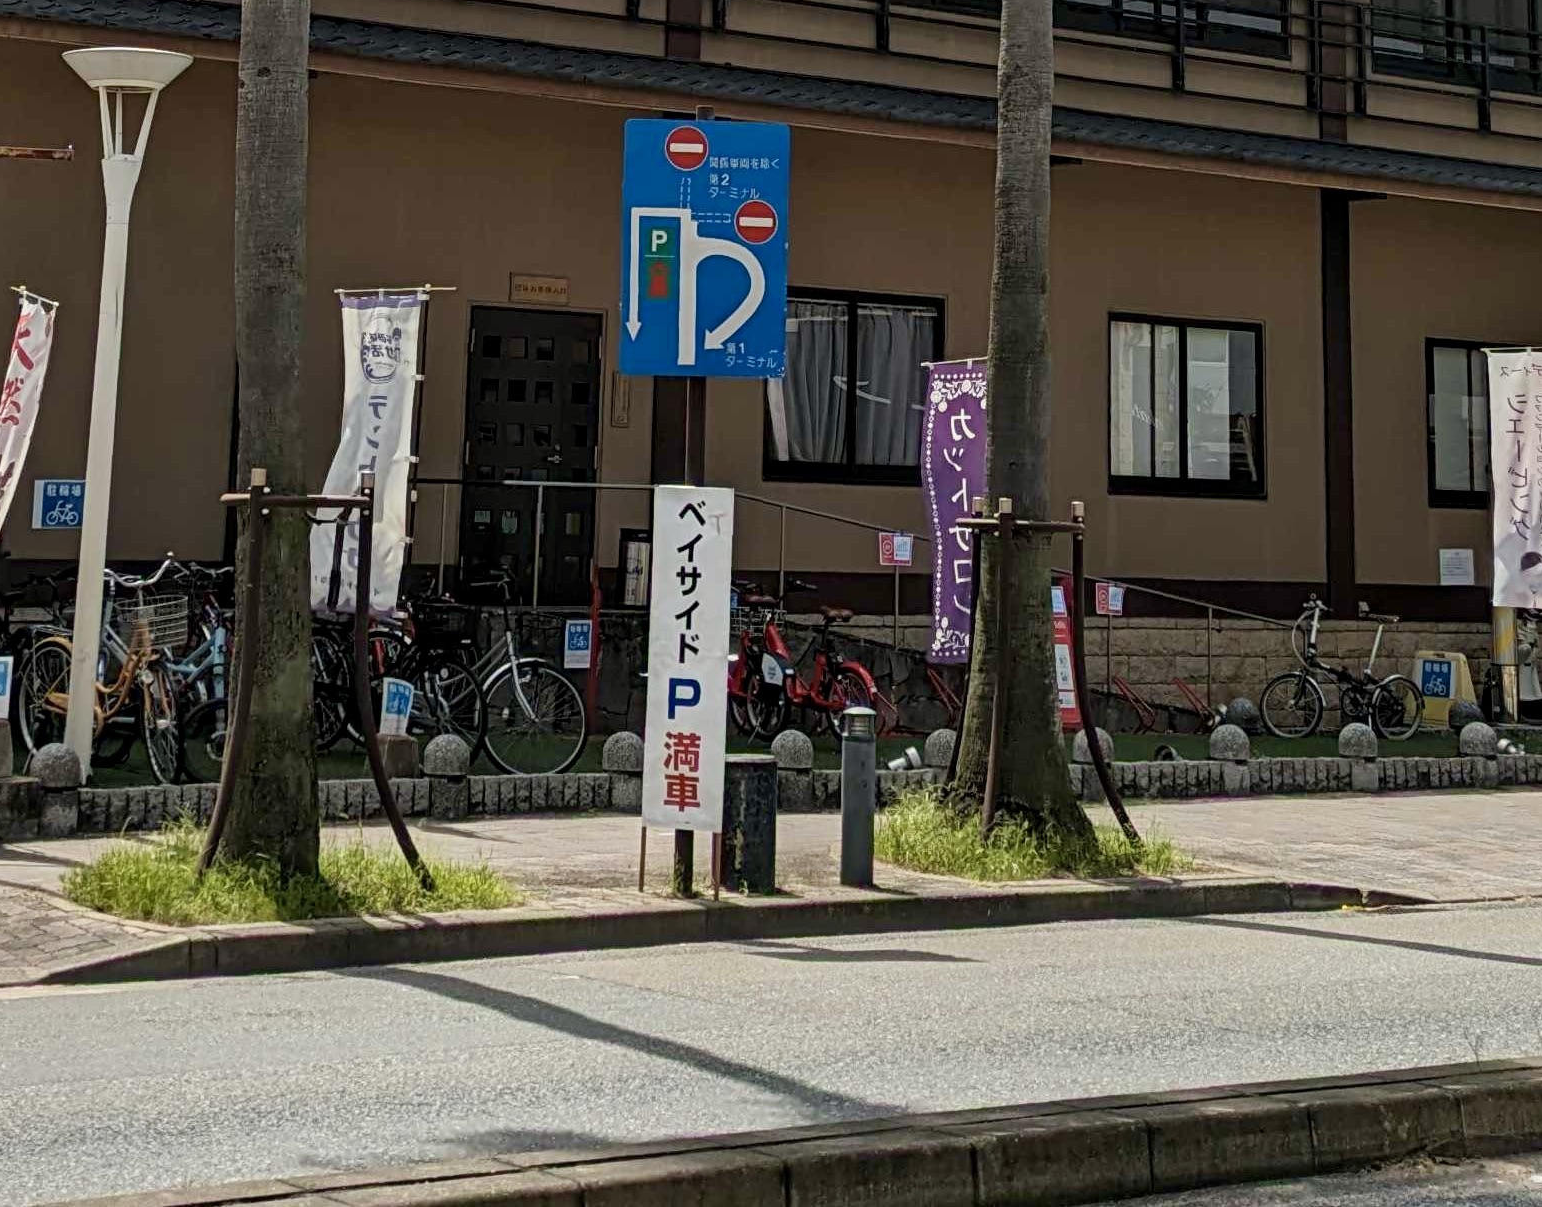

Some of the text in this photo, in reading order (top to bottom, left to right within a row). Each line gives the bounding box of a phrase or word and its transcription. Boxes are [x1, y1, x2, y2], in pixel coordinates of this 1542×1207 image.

[709, 173, 730, 186] 第2
[708, 186, 760, 199] ターミナル
[651, 230, 668, 252] P
[726, 342, 746, 354] 第1
[725, 356, 777, 369] ターミナル
[663, 501, 707, 812] ベイサイド P 満車
